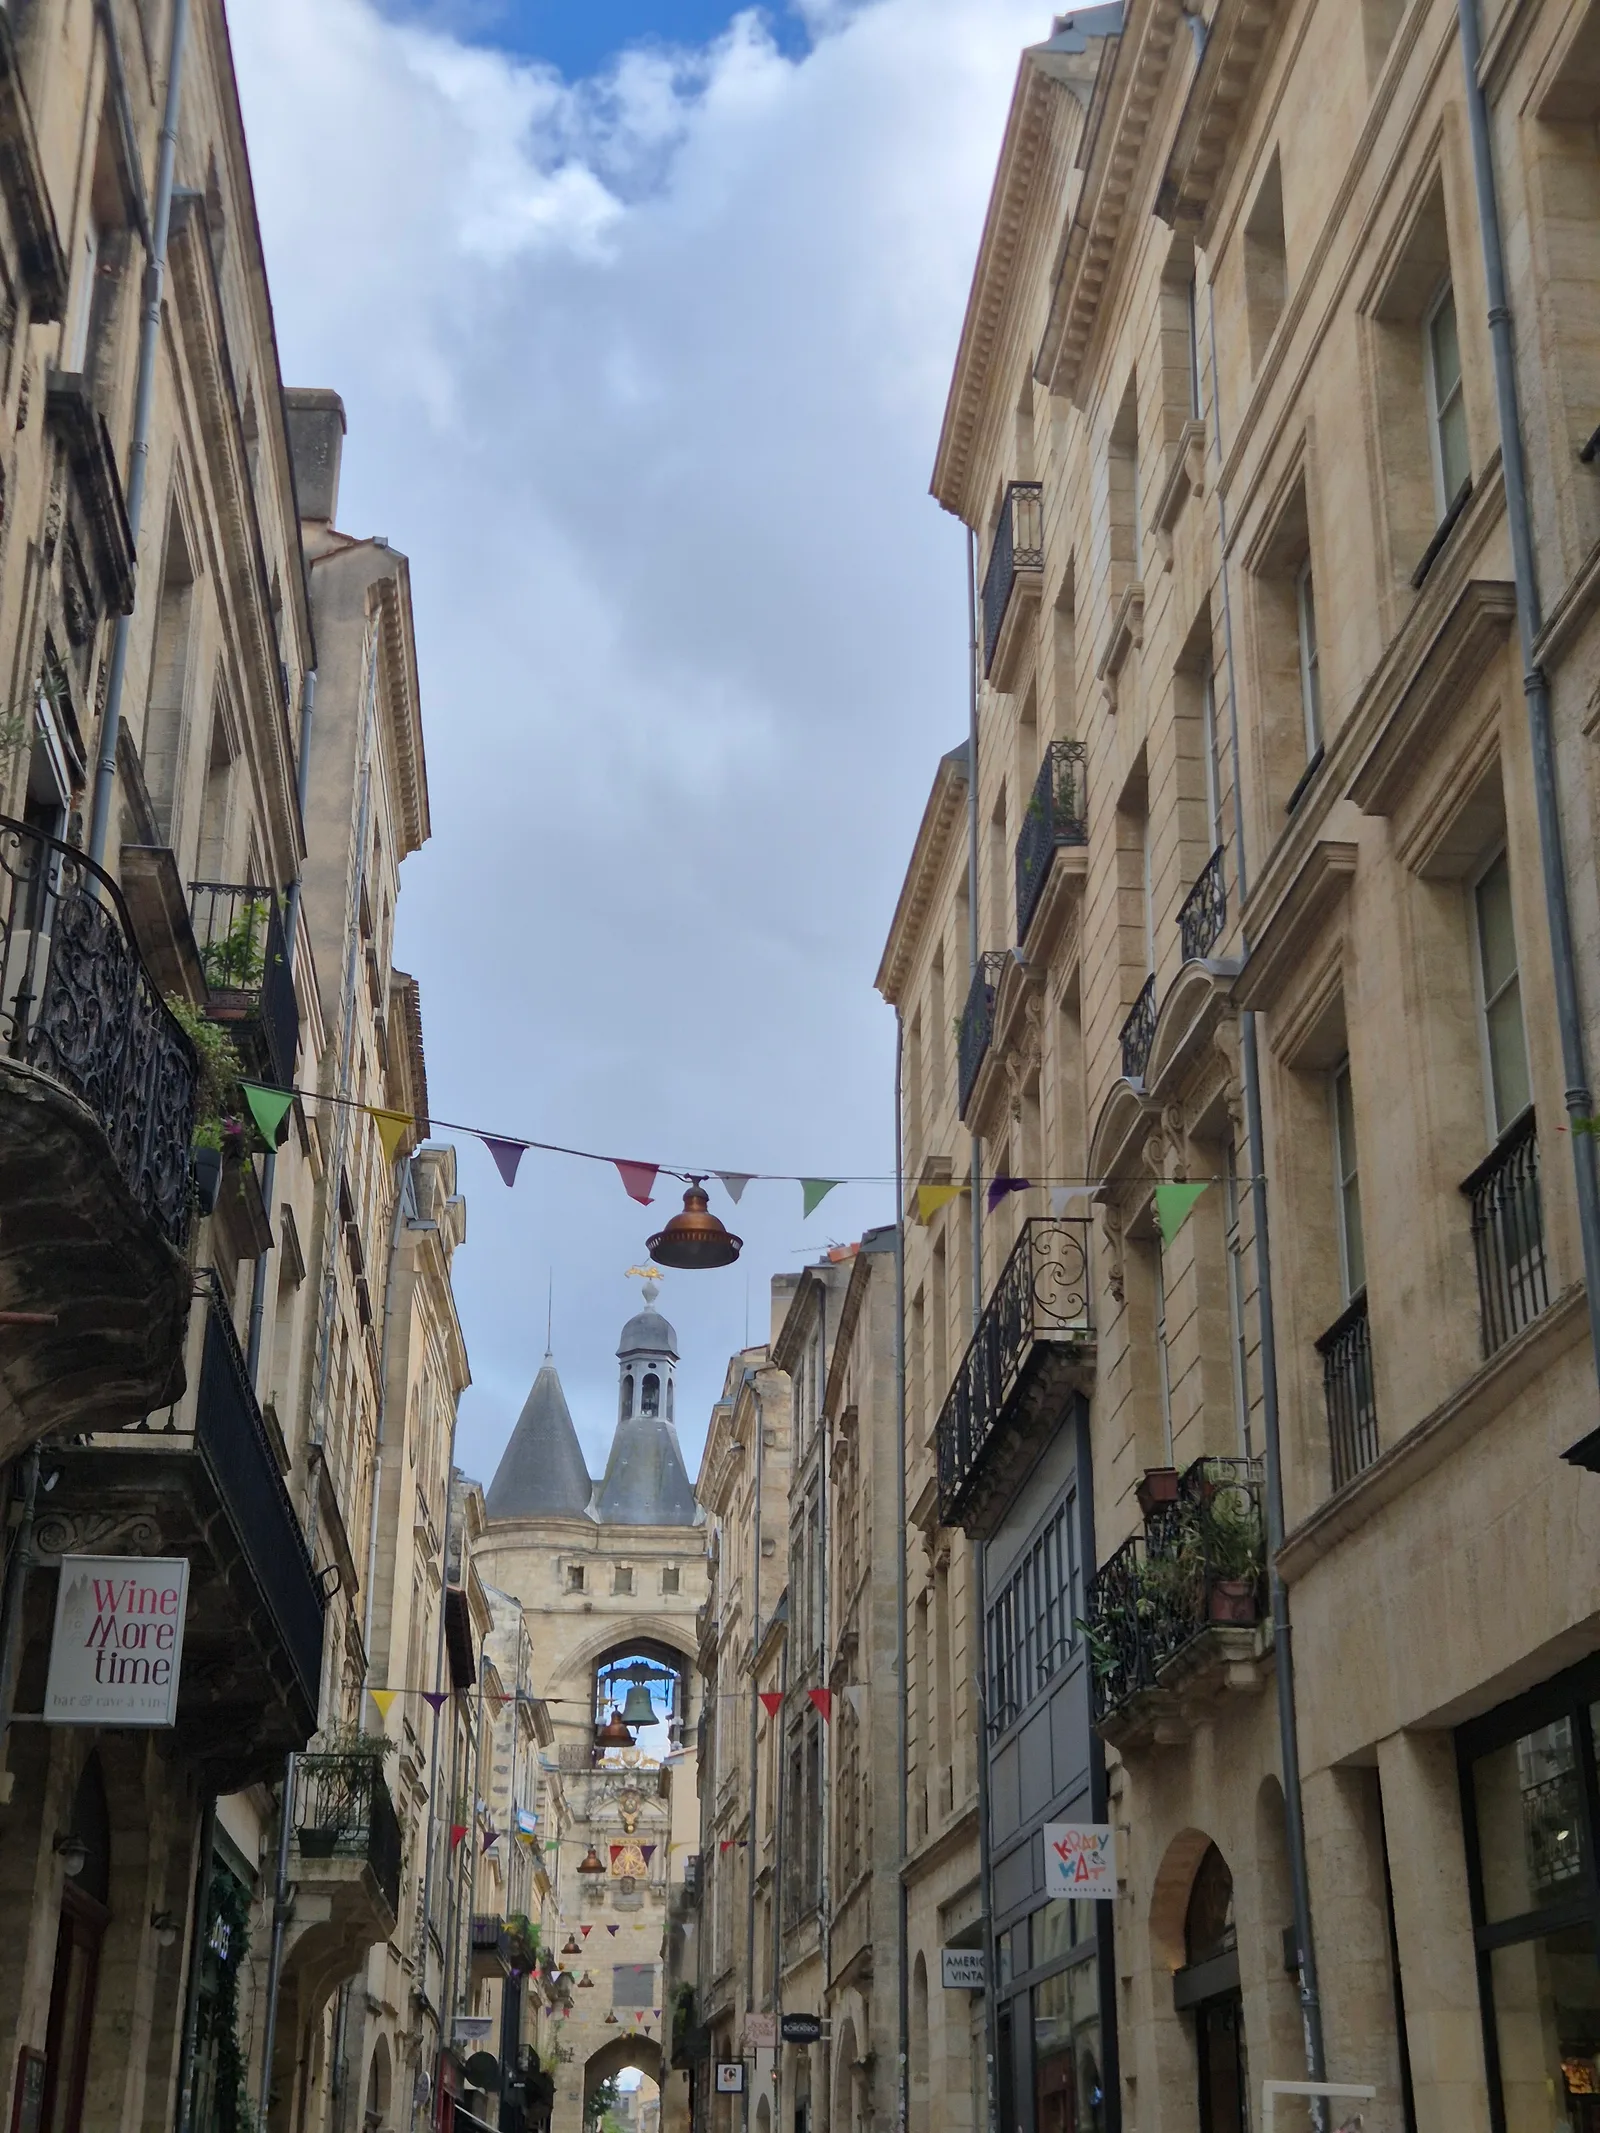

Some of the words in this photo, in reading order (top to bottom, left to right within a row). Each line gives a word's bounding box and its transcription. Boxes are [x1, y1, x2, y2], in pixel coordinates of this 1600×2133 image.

[92, 1579, 178, 1616] Wine
[84, 1614, 174, 1650] More
[95, 1649, 170, 1686] time
[53, 1694, 76, 1707] bar
[1053, 1830, 1109, 1861] KRAZY
[1058, 1852, 1106, 1883] KAT
[946, 1956, 985, 1967] AMERIC
[951, 1970, 984, 1981] VINTA
